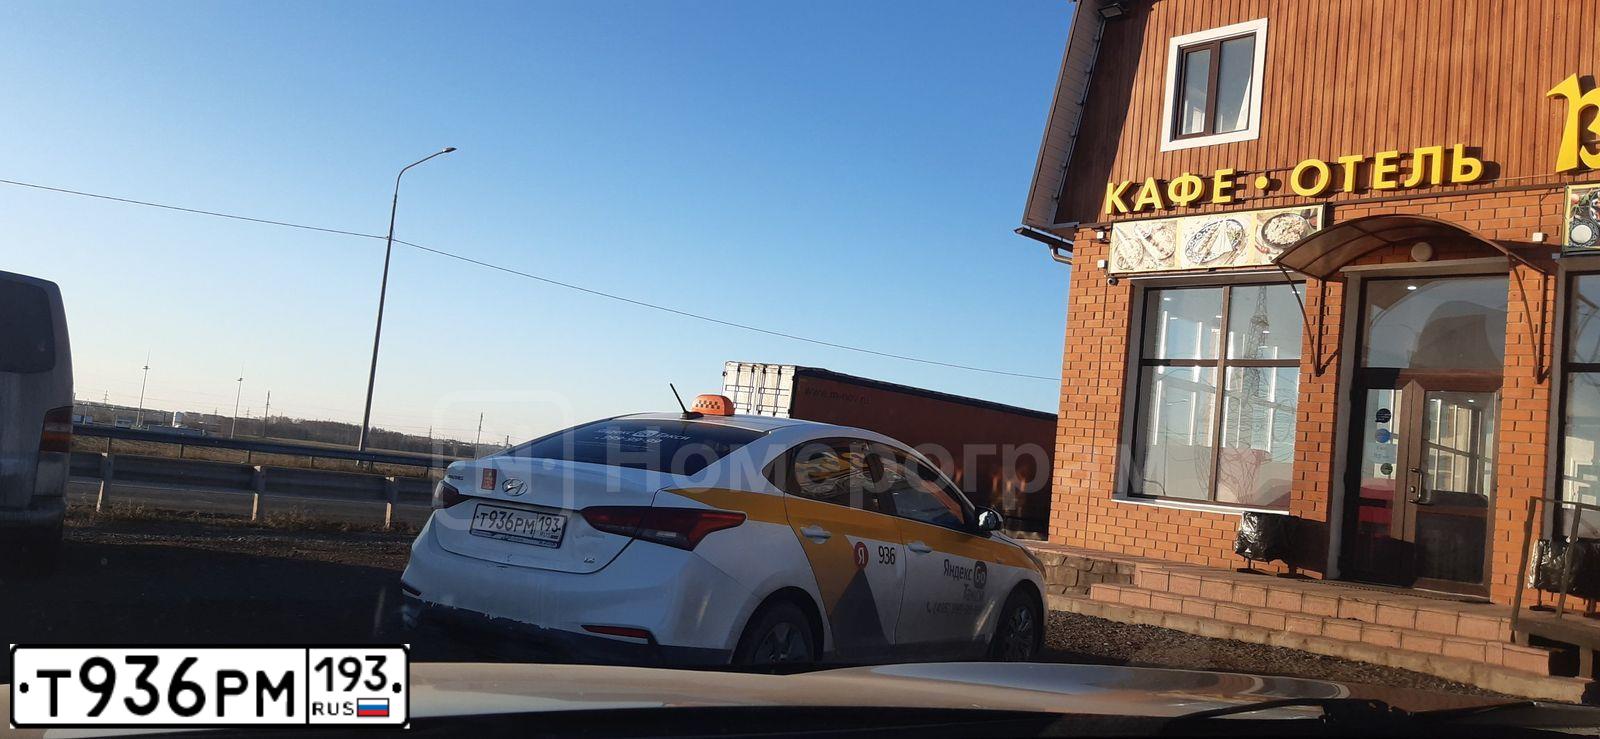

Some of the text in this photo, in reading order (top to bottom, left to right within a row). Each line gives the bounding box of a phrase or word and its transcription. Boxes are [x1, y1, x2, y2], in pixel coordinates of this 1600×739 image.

[1105, 143, 1485, 214] КАФЕ ОТЕЛЬ
[480, 511, 559, 534] Т936РМ 193
[878, 545, 896, 565] 936
[943, 558, 973, 581] Яндекс
